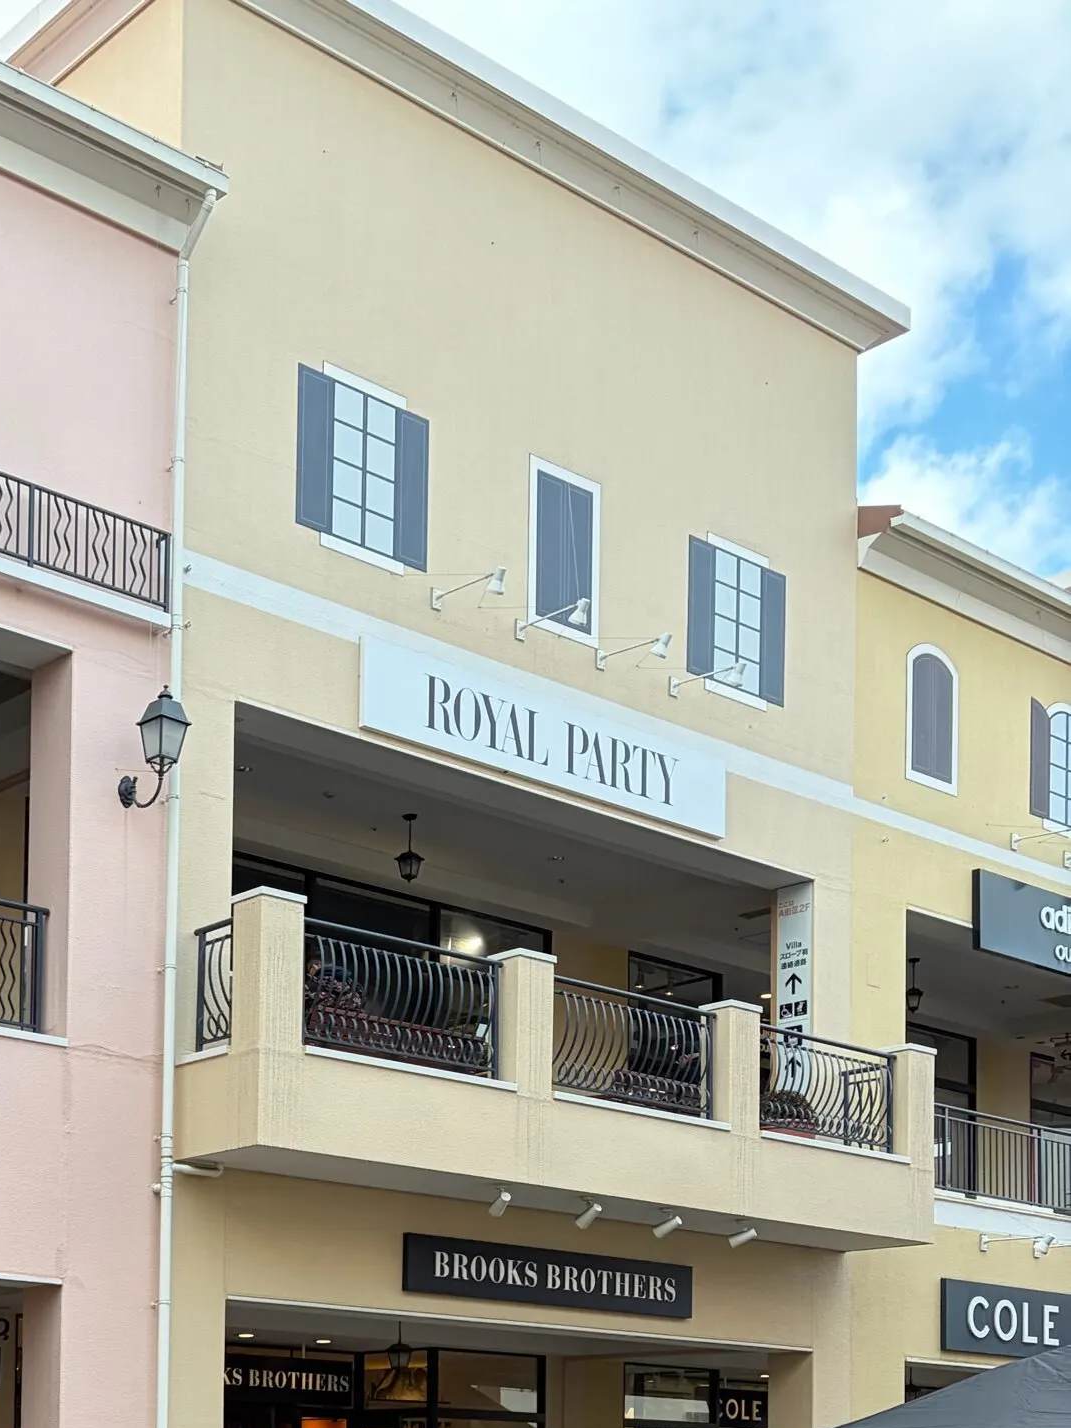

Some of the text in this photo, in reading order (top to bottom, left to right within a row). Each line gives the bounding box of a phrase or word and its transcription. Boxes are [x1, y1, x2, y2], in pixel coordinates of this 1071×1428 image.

[424, 673, 680, 806] ROYAL PARTY
[785, 940, 802, 950] Villa
[434, 1250, 676, 1303] BROOKS BROTHERS
[967, 1295, 1060, 1346] COLE
[248, 1368, 349, 1393] BROTHERS
